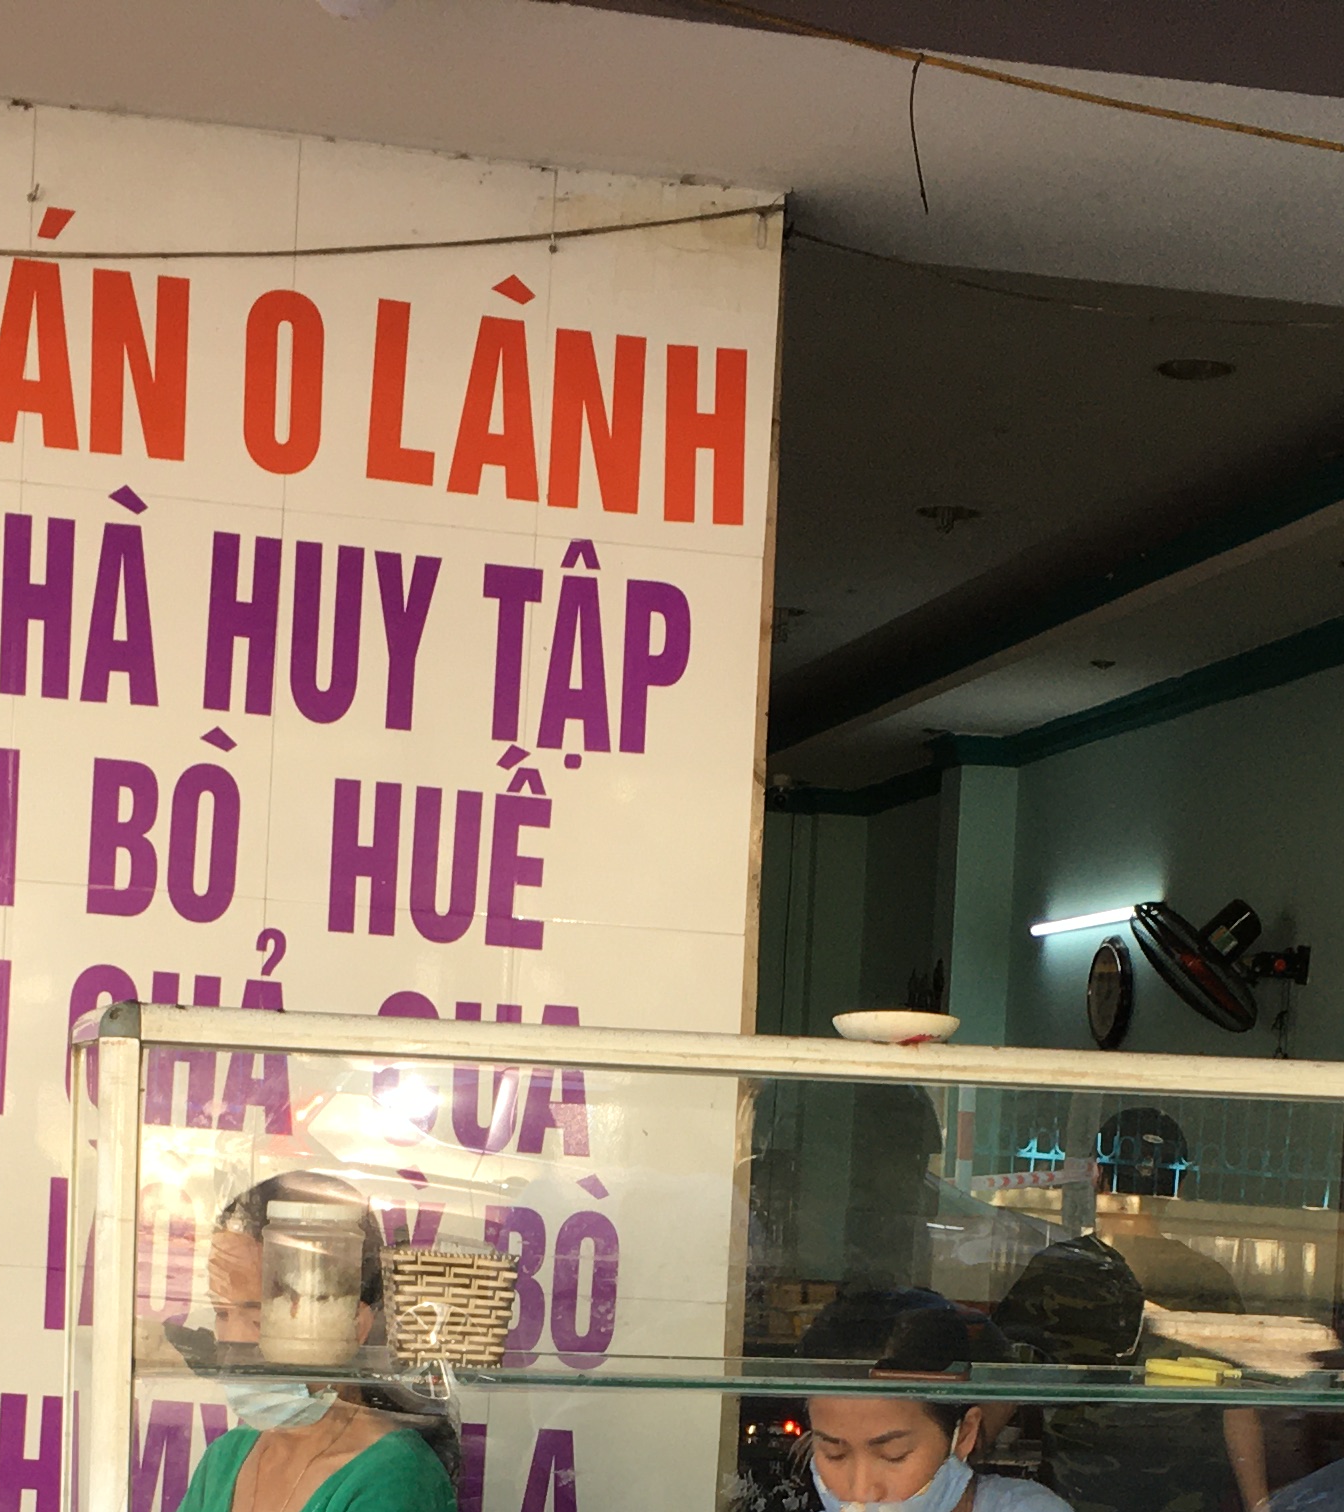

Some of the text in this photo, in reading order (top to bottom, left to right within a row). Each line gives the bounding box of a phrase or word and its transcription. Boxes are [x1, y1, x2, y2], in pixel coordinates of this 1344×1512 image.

[243, 288, 325, 475] O
[365, 273, 749, 526] LÀNH
[203, 530, 442, 732] HUY
[482, 538, 692, 770] TẬP
[86, 725, 243, 923] BÒ
[327, 746, 553, 950] HUẾ
